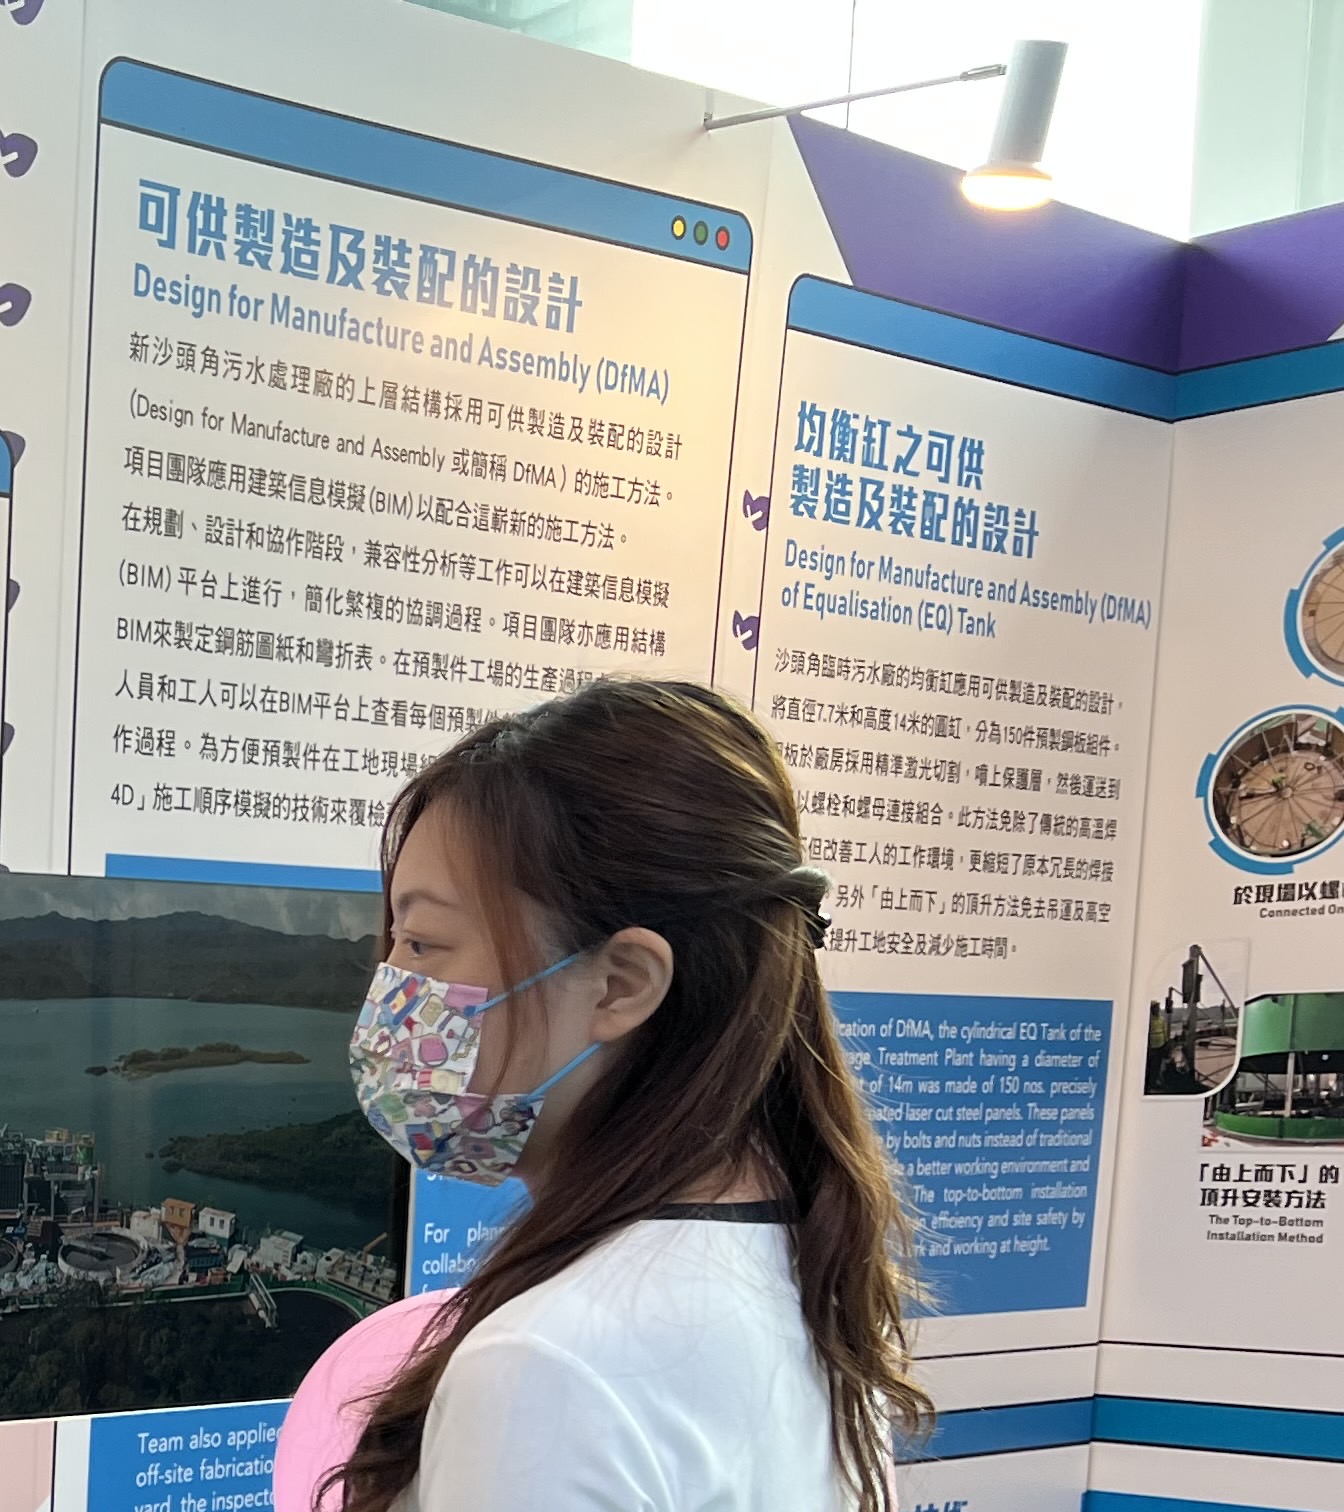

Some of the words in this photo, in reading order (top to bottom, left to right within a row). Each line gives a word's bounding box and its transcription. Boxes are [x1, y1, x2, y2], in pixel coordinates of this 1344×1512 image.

[136, 178, 583, 334] 可供製造及裝配的設計
[133, 263, 223, 317] Design
[228, 283, 264, 313] for
[270, 292, 425, 355] Manufacture
[430, 331, 473, 365] and
[477, 340, 591, 395] Assembly
[595, 356, 670, 405] (DfMA)
[794, 400, 986, 492] 均衡缸之可供
[789, 463, 1040, 560] 製造及裝配的設計
[781, 580, 800, 609] of
[803, 582, 912, 626] Equalisation
[917, 600, 953, 636] (EQ)
[957, 607, 997, 639] Tank
[785, 538, 846, 581] Design
[850, 550, 875, 573] for
[878, 555, 984, 599] Manufacture
[987, 578, 1017, 602] and
[1020, 580, 1097, 625] Assembly
[1100, 593, 1152, 630] (DfMA)
[1207, 1230, 1275, 1243] Installation
[1277, 1231, 1324, 1244] Method
[1208, 1214, 1230, 1226] The
[1232, 1215, 1324, 1229] Top-to-Bottom
[137, 1432, 183, 1454] Team
[189, 1427, 221, 1449] also
